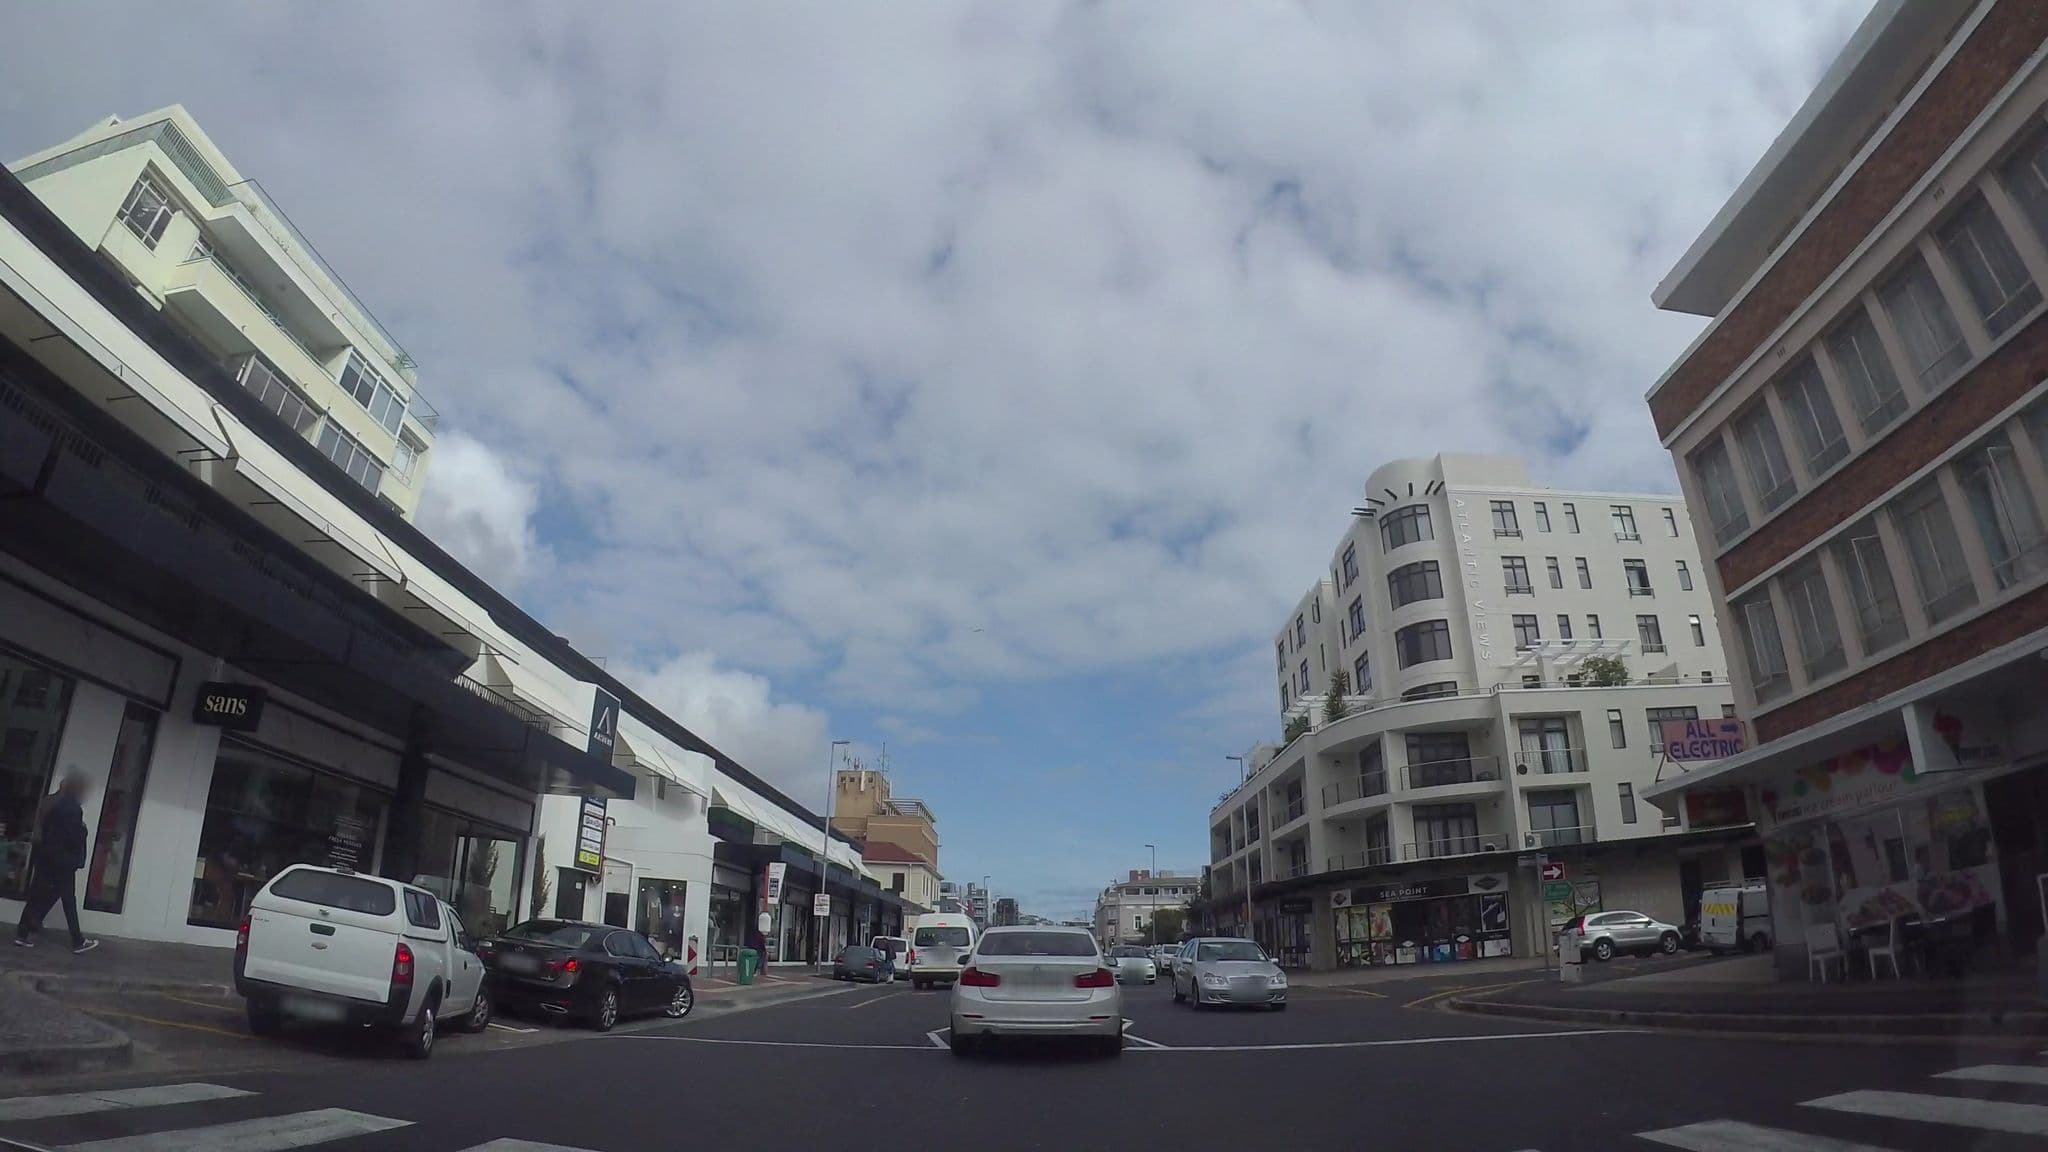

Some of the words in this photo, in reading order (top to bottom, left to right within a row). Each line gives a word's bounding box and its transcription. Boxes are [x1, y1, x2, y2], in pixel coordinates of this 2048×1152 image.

[1455, 499, 1480, 590] ATLANTIC
[1473, 600, 1491, 661] VIEWS
[204, 695, 248, 716] sans
[1686, 720, 1716, 739] ALL
[1670, 739, 1743, 759] ELECTRIC
[1379, 890, 1397, 899] SEA
[1399, 886, 1428, 897] POINT
